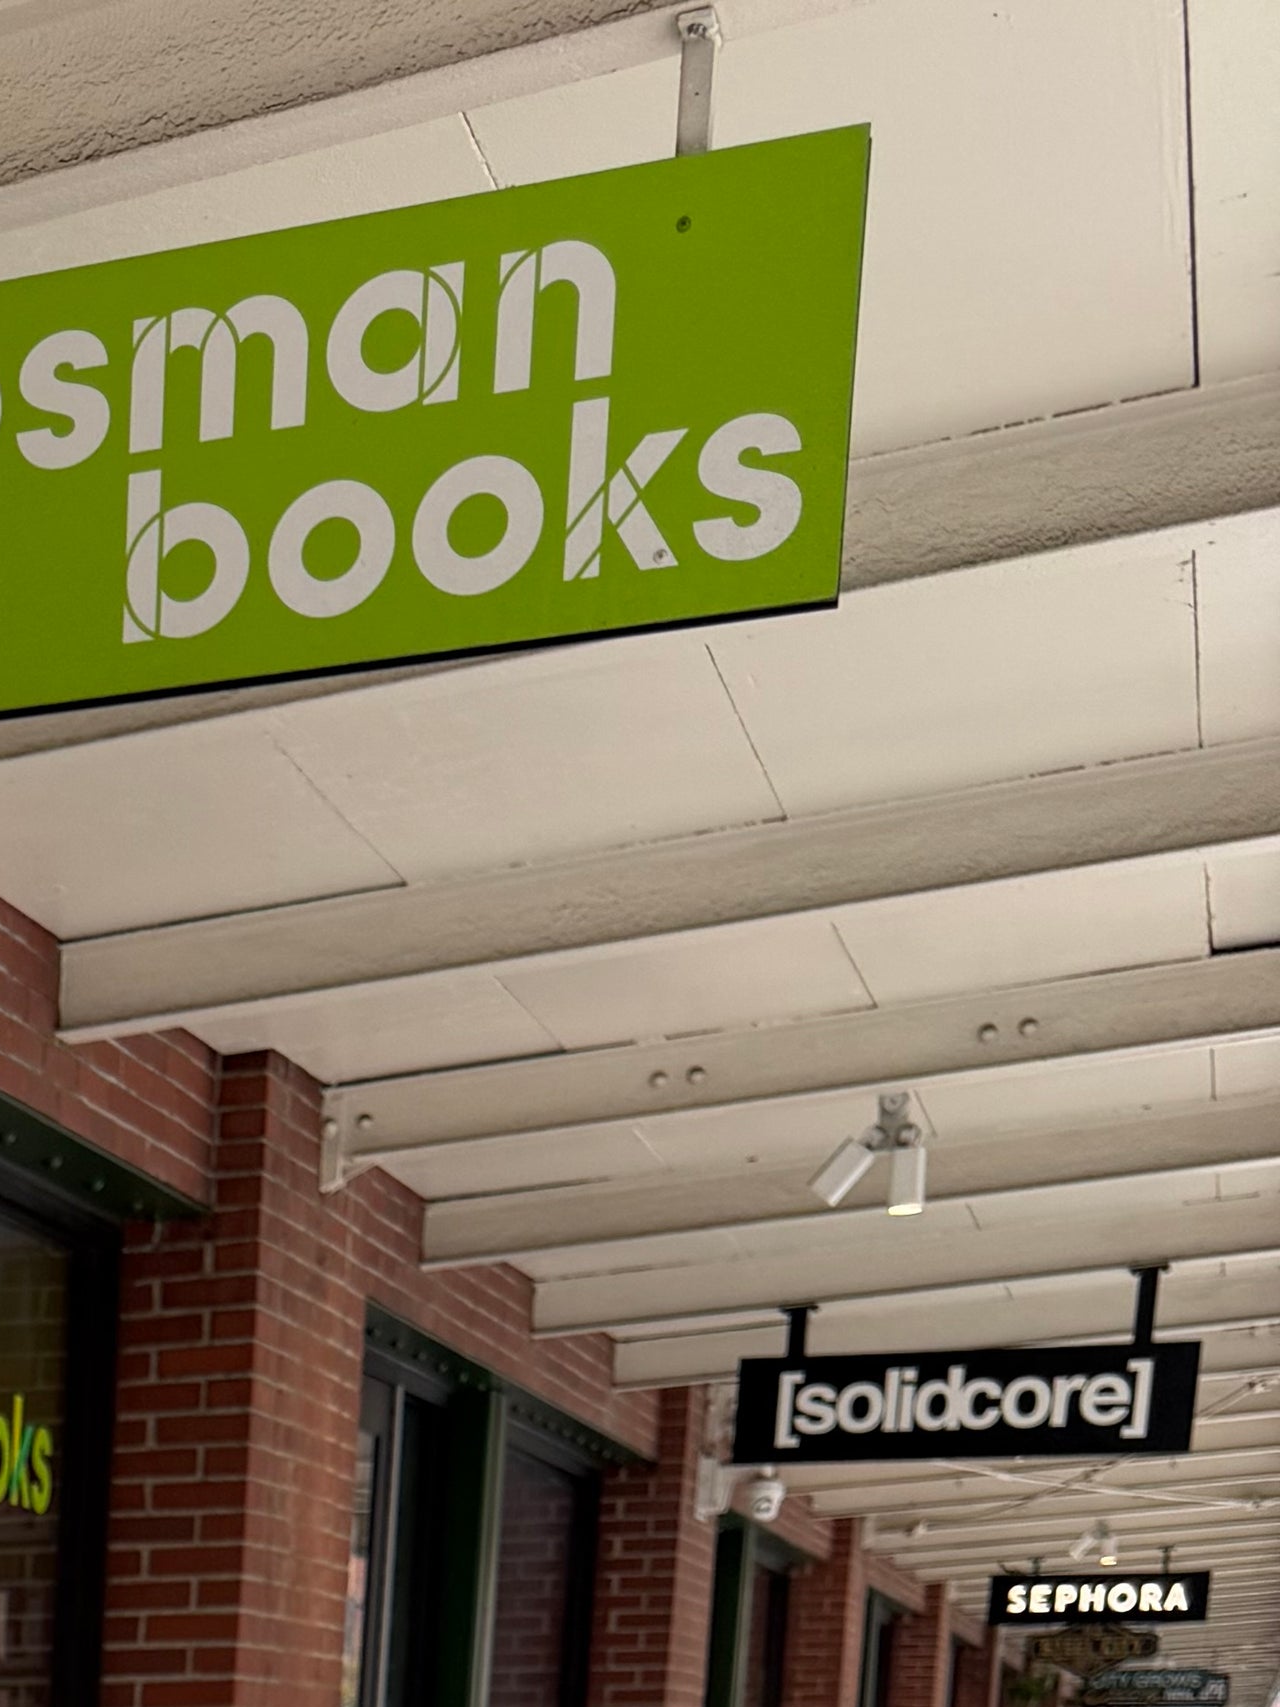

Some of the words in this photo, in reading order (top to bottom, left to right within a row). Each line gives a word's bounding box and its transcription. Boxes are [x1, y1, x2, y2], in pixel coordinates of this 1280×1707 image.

[122, 397, 803, 644] books
[773, 1357, 1155, 1449] [solidcore]
[1005, 1582, 1189, 1614] SEPHORA
